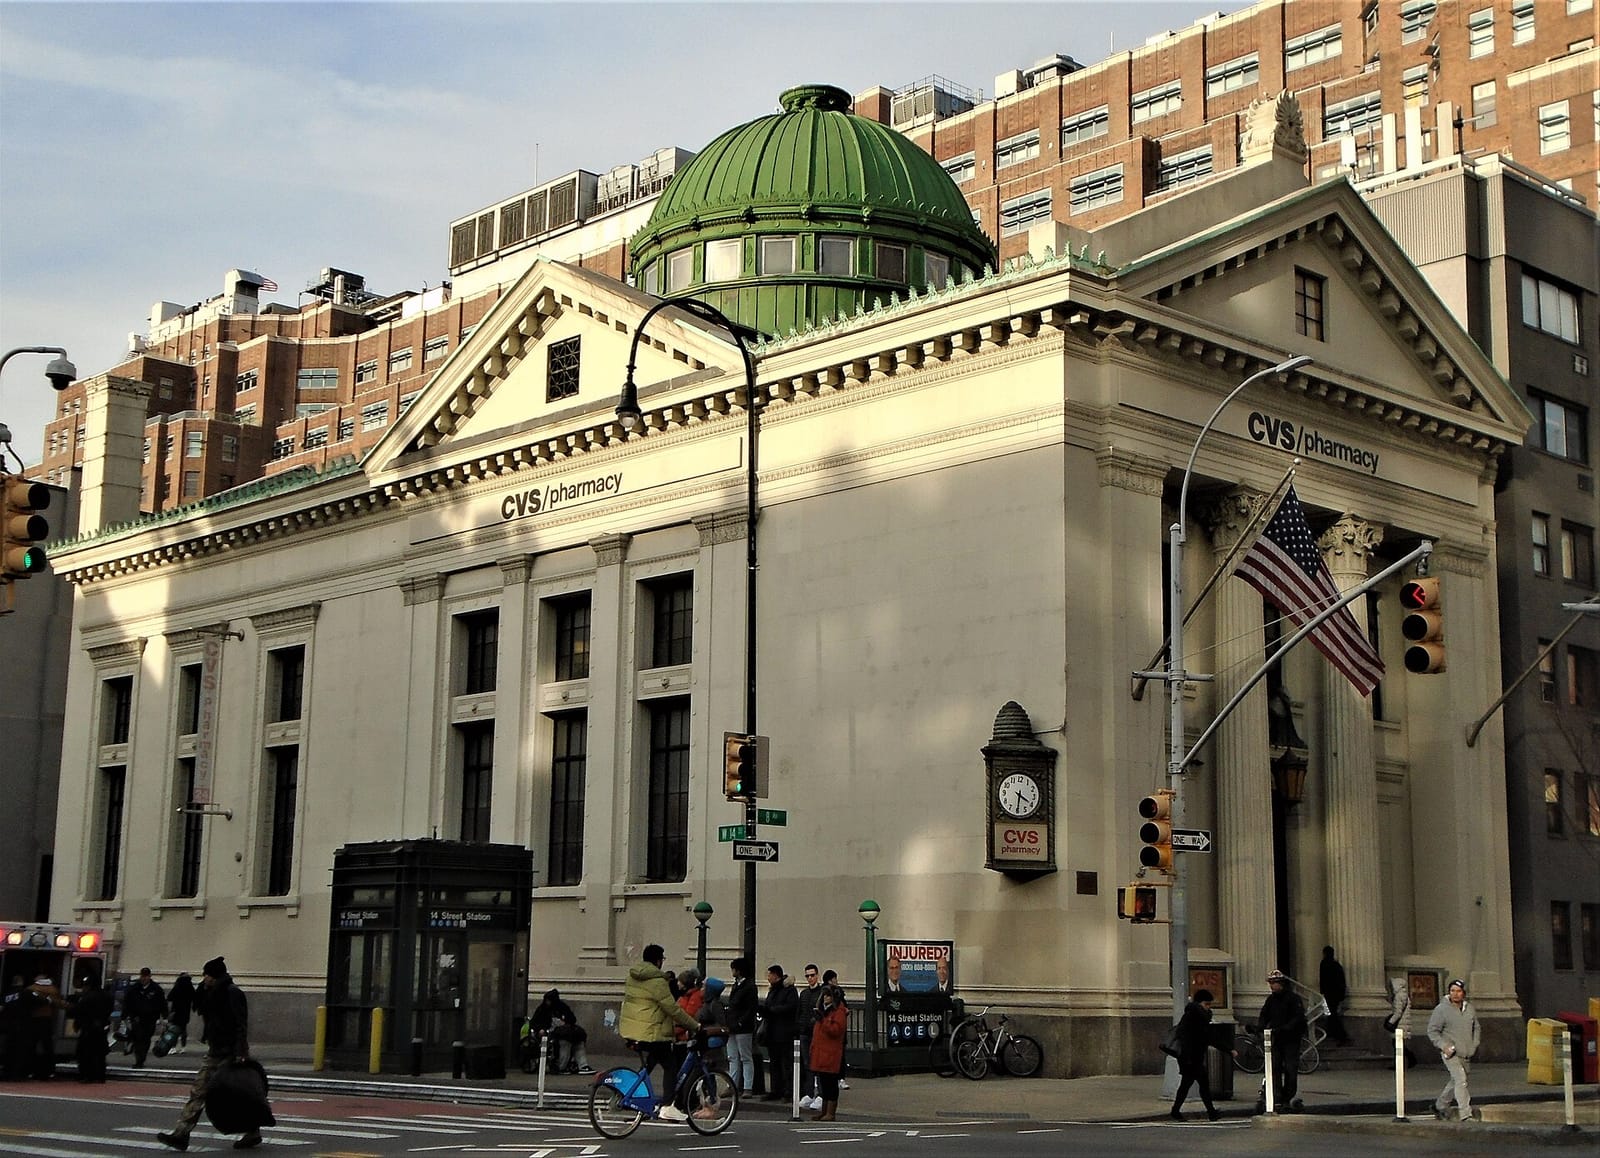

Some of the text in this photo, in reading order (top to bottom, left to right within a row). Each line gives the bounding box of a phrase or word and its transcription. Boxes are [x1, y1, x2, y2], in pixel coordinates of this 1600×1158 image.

[1248, 411, 1379, 474] CVS/pharmacy
[501, 472, 623, 519] CVS/pharmacy
[1010, 776, 1016, 784] 11
[1002, 789, 1006, 797] 9
[1031, 785, 1035, 793] 2
[1003, 829, 1039, 844] CVS
[740, 846, 772, 856] ONE WAY
[1001, 845, 1041, 855] pharmacy
[430, 911, 492, 921] 14 Street Station
[889, 945, 949, 960] INJURED?
[889, 1013, 942, 1022] 14 Street Station
[891, 1025, 936, 1037] A C E L
